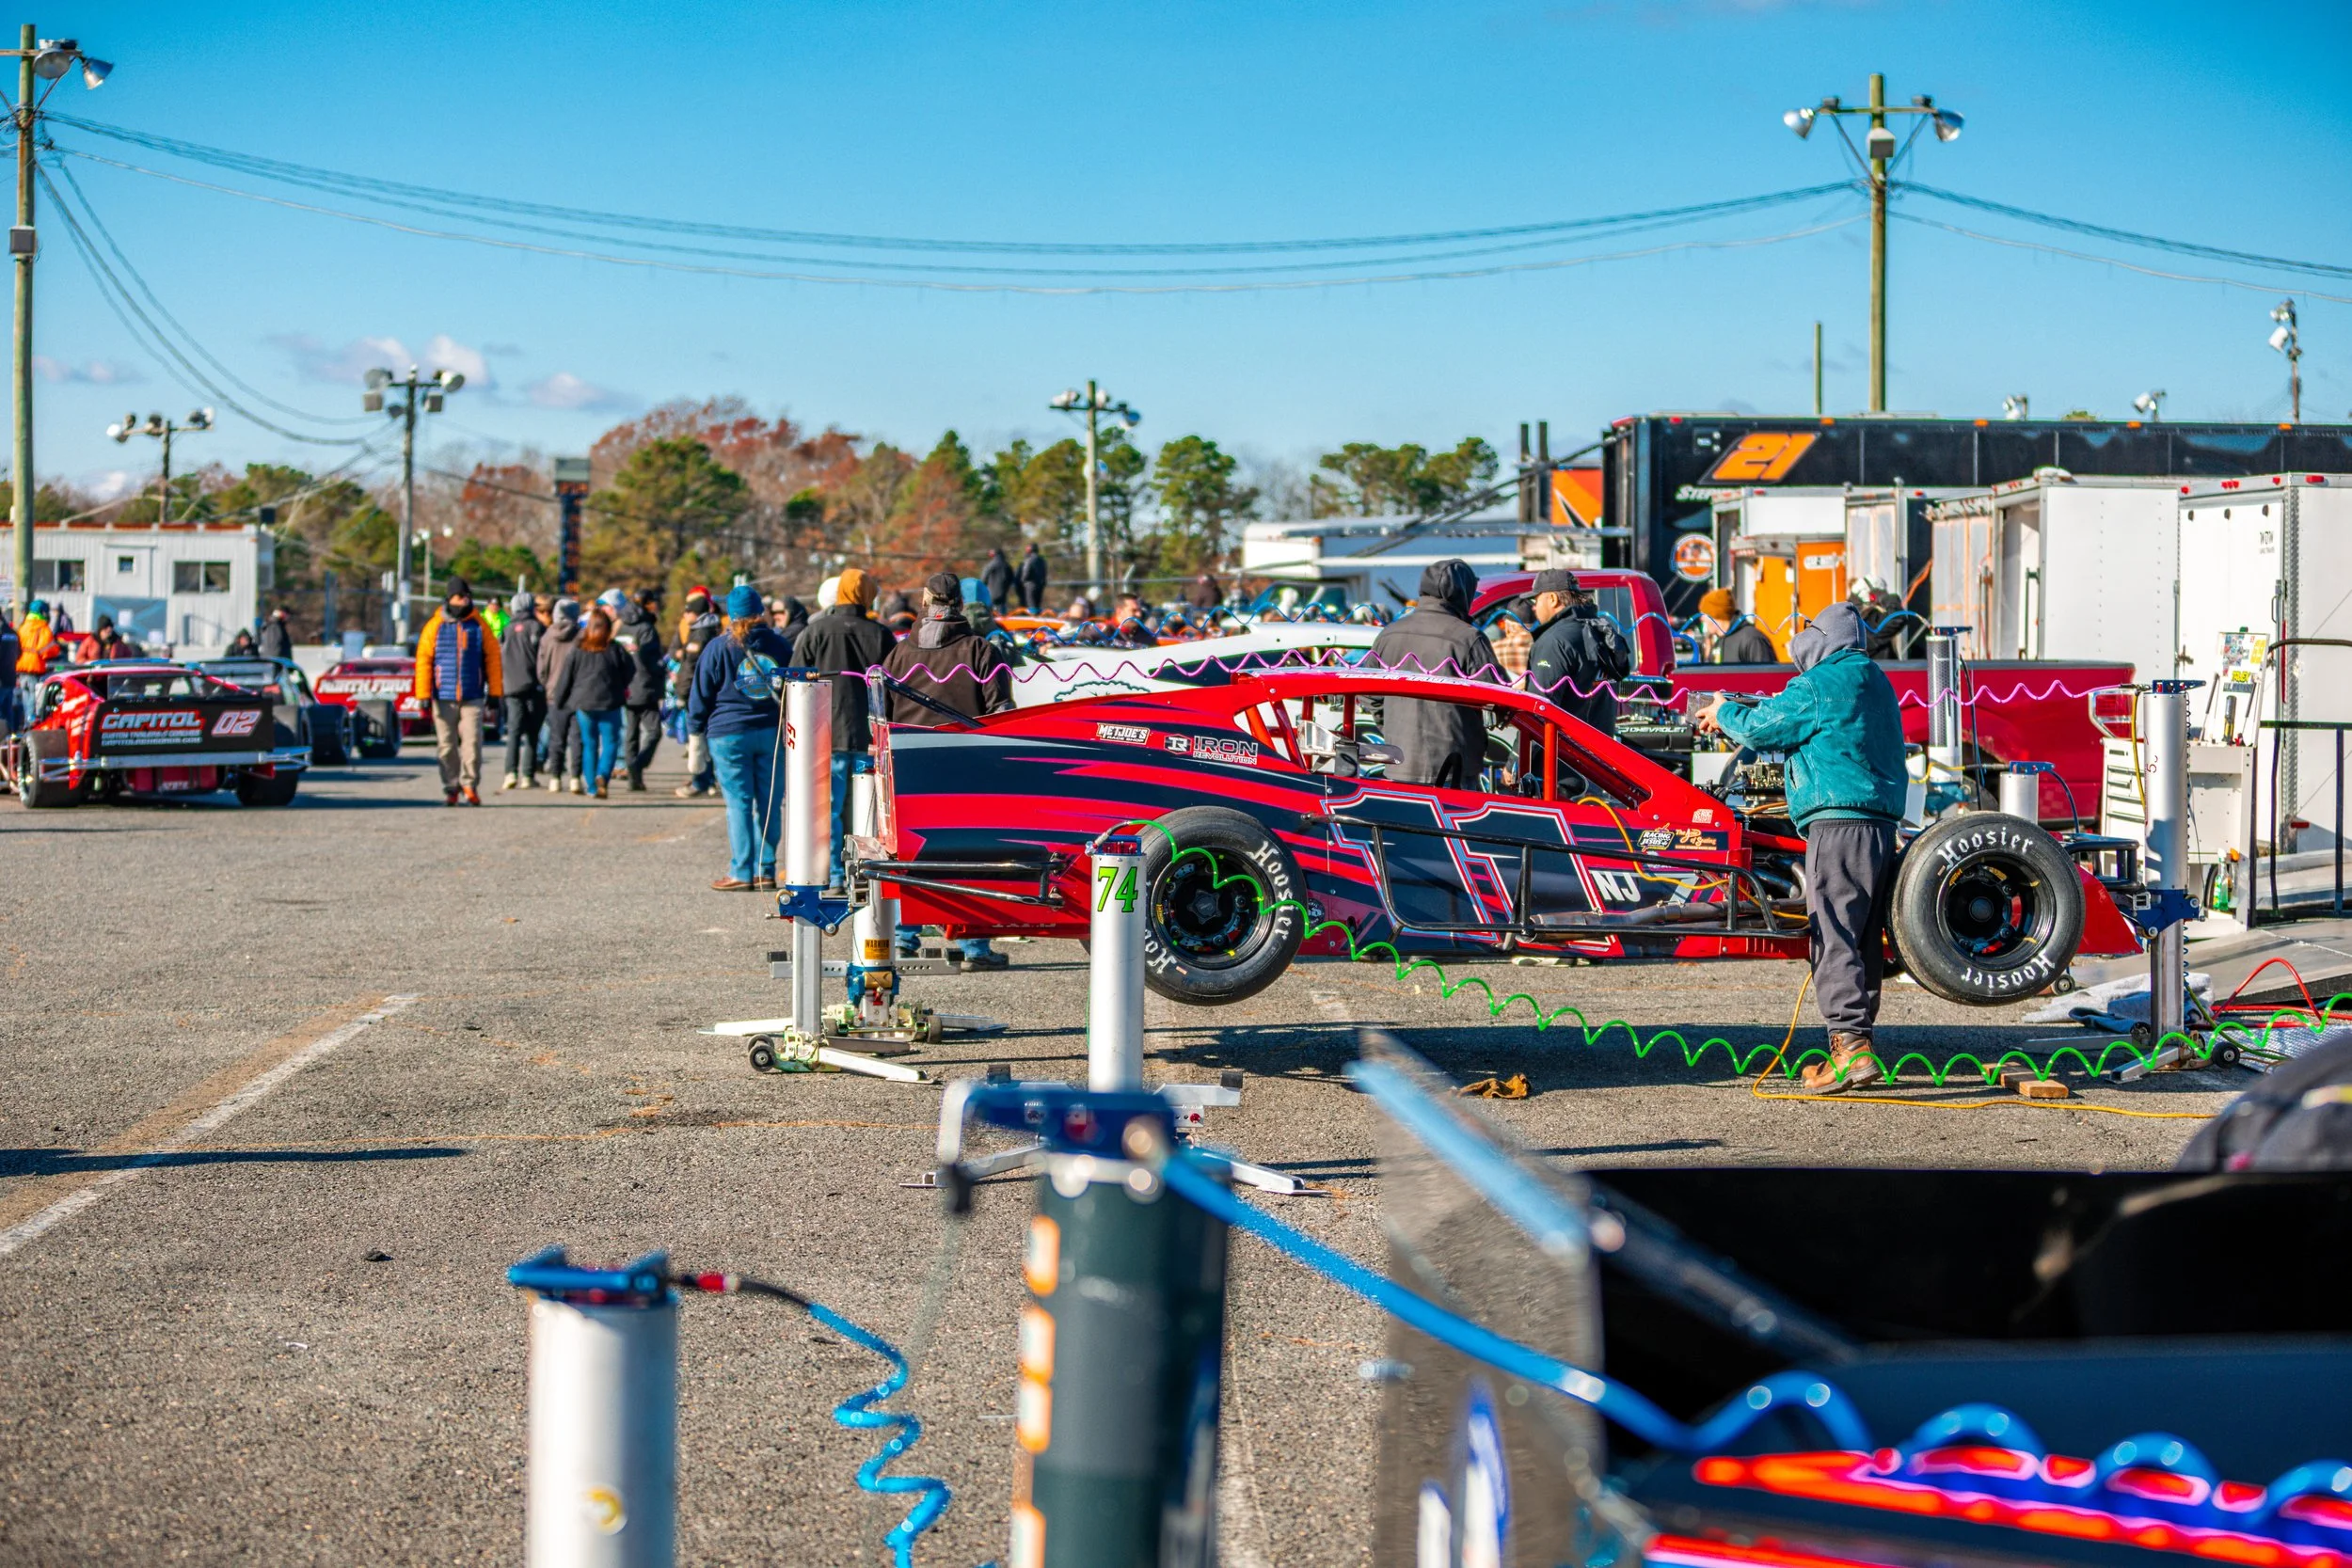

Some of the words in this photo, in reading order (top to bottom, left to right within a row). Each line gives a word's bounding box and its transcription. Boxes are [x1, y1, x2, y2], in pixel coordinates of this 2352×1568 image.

[1711, 432, 1817, 481] 21
[102, 711, 201, 730] CAPITOL
[212, 710, 262, 736] 02
[1098, 724, 1148, 739] METJOE'S
[1193, 736, 1259, 756] IRON
[1193, 752, 1258, 766] REVOLUTION
[1643, 832, 1671, 840] RACING
[1937, 827, 2034, 870] Hoosier
[1097, 866, 1138, 912] 74
[1590, 870, 1641, 903] NJ
[1961, 950, 2057, 989] Hoosier
